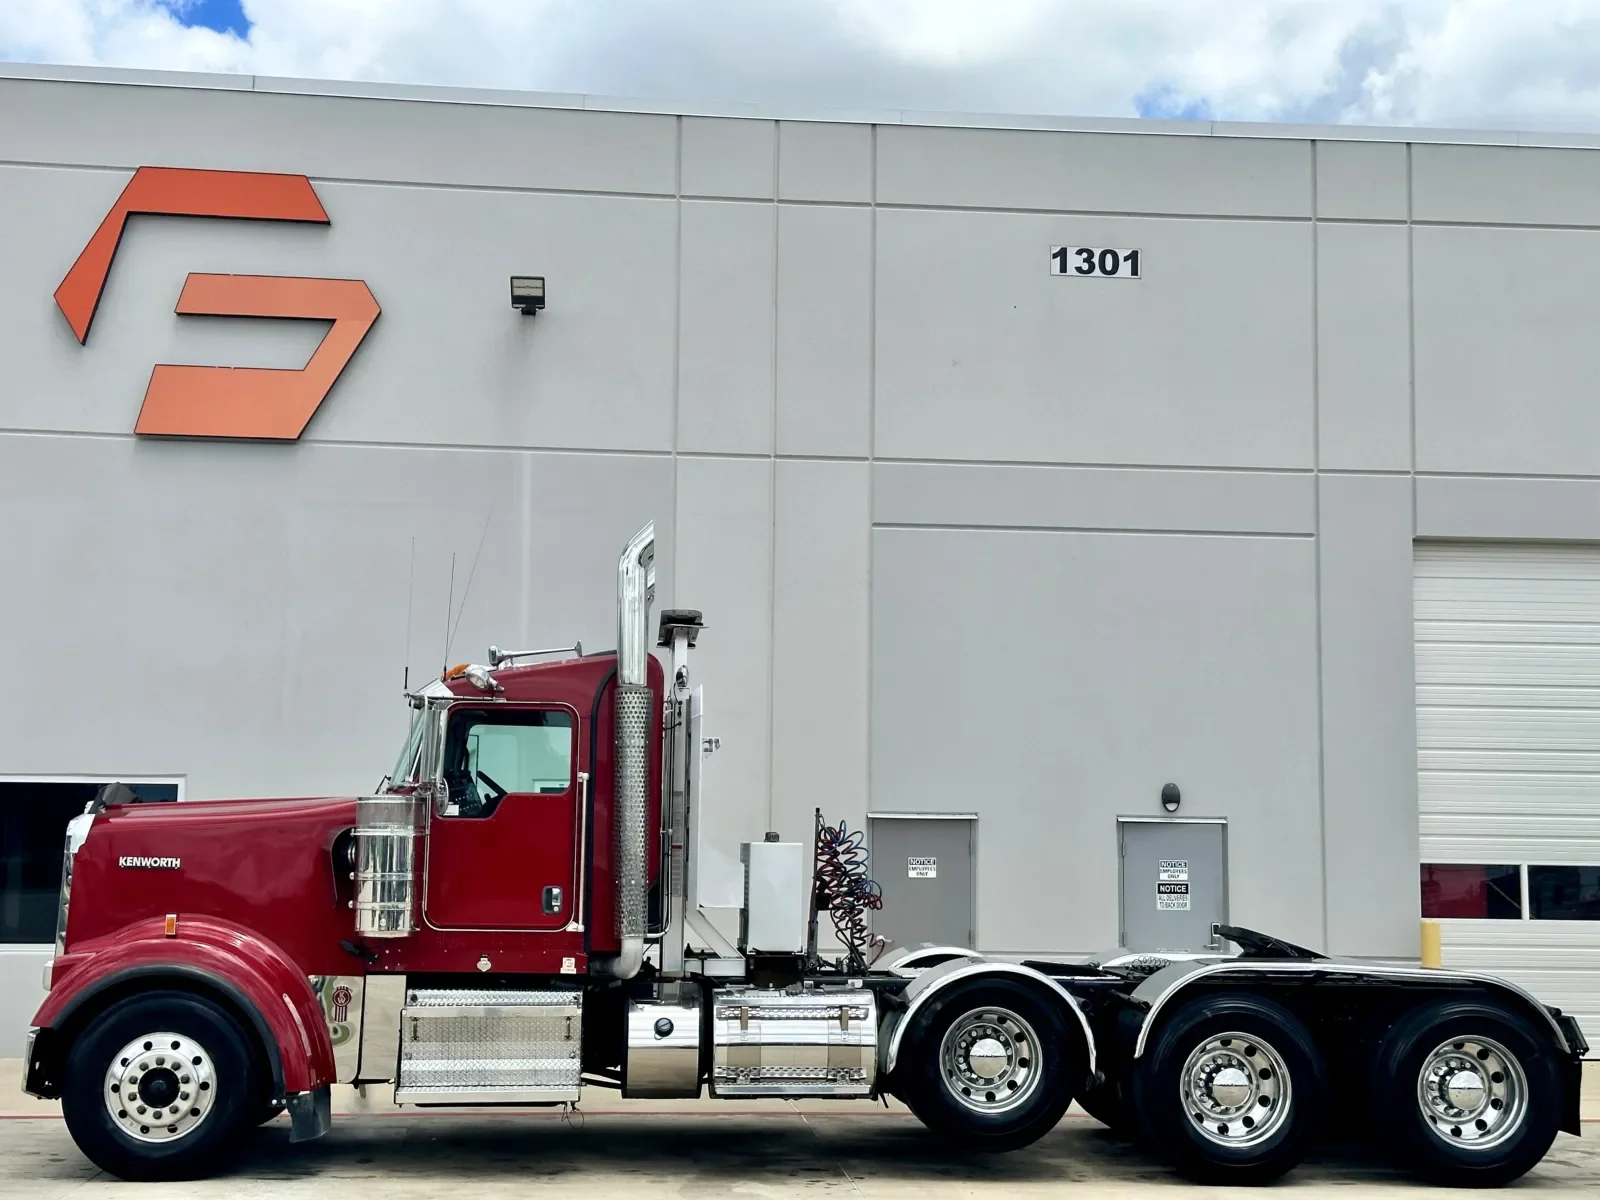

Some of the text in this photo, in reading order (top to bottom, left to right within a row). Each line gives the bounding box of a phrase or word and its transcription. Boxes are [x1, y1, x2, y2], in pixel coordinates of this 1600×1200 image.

[1052, 247, 1139, 276] 1301
[119, 856, 181, 868] KENWORTH
[1159, 884, 1187, 893] NOTICE
[1165, 901, 1175, 909] BACK
[1176, 901, 1188, 909] DOOR
